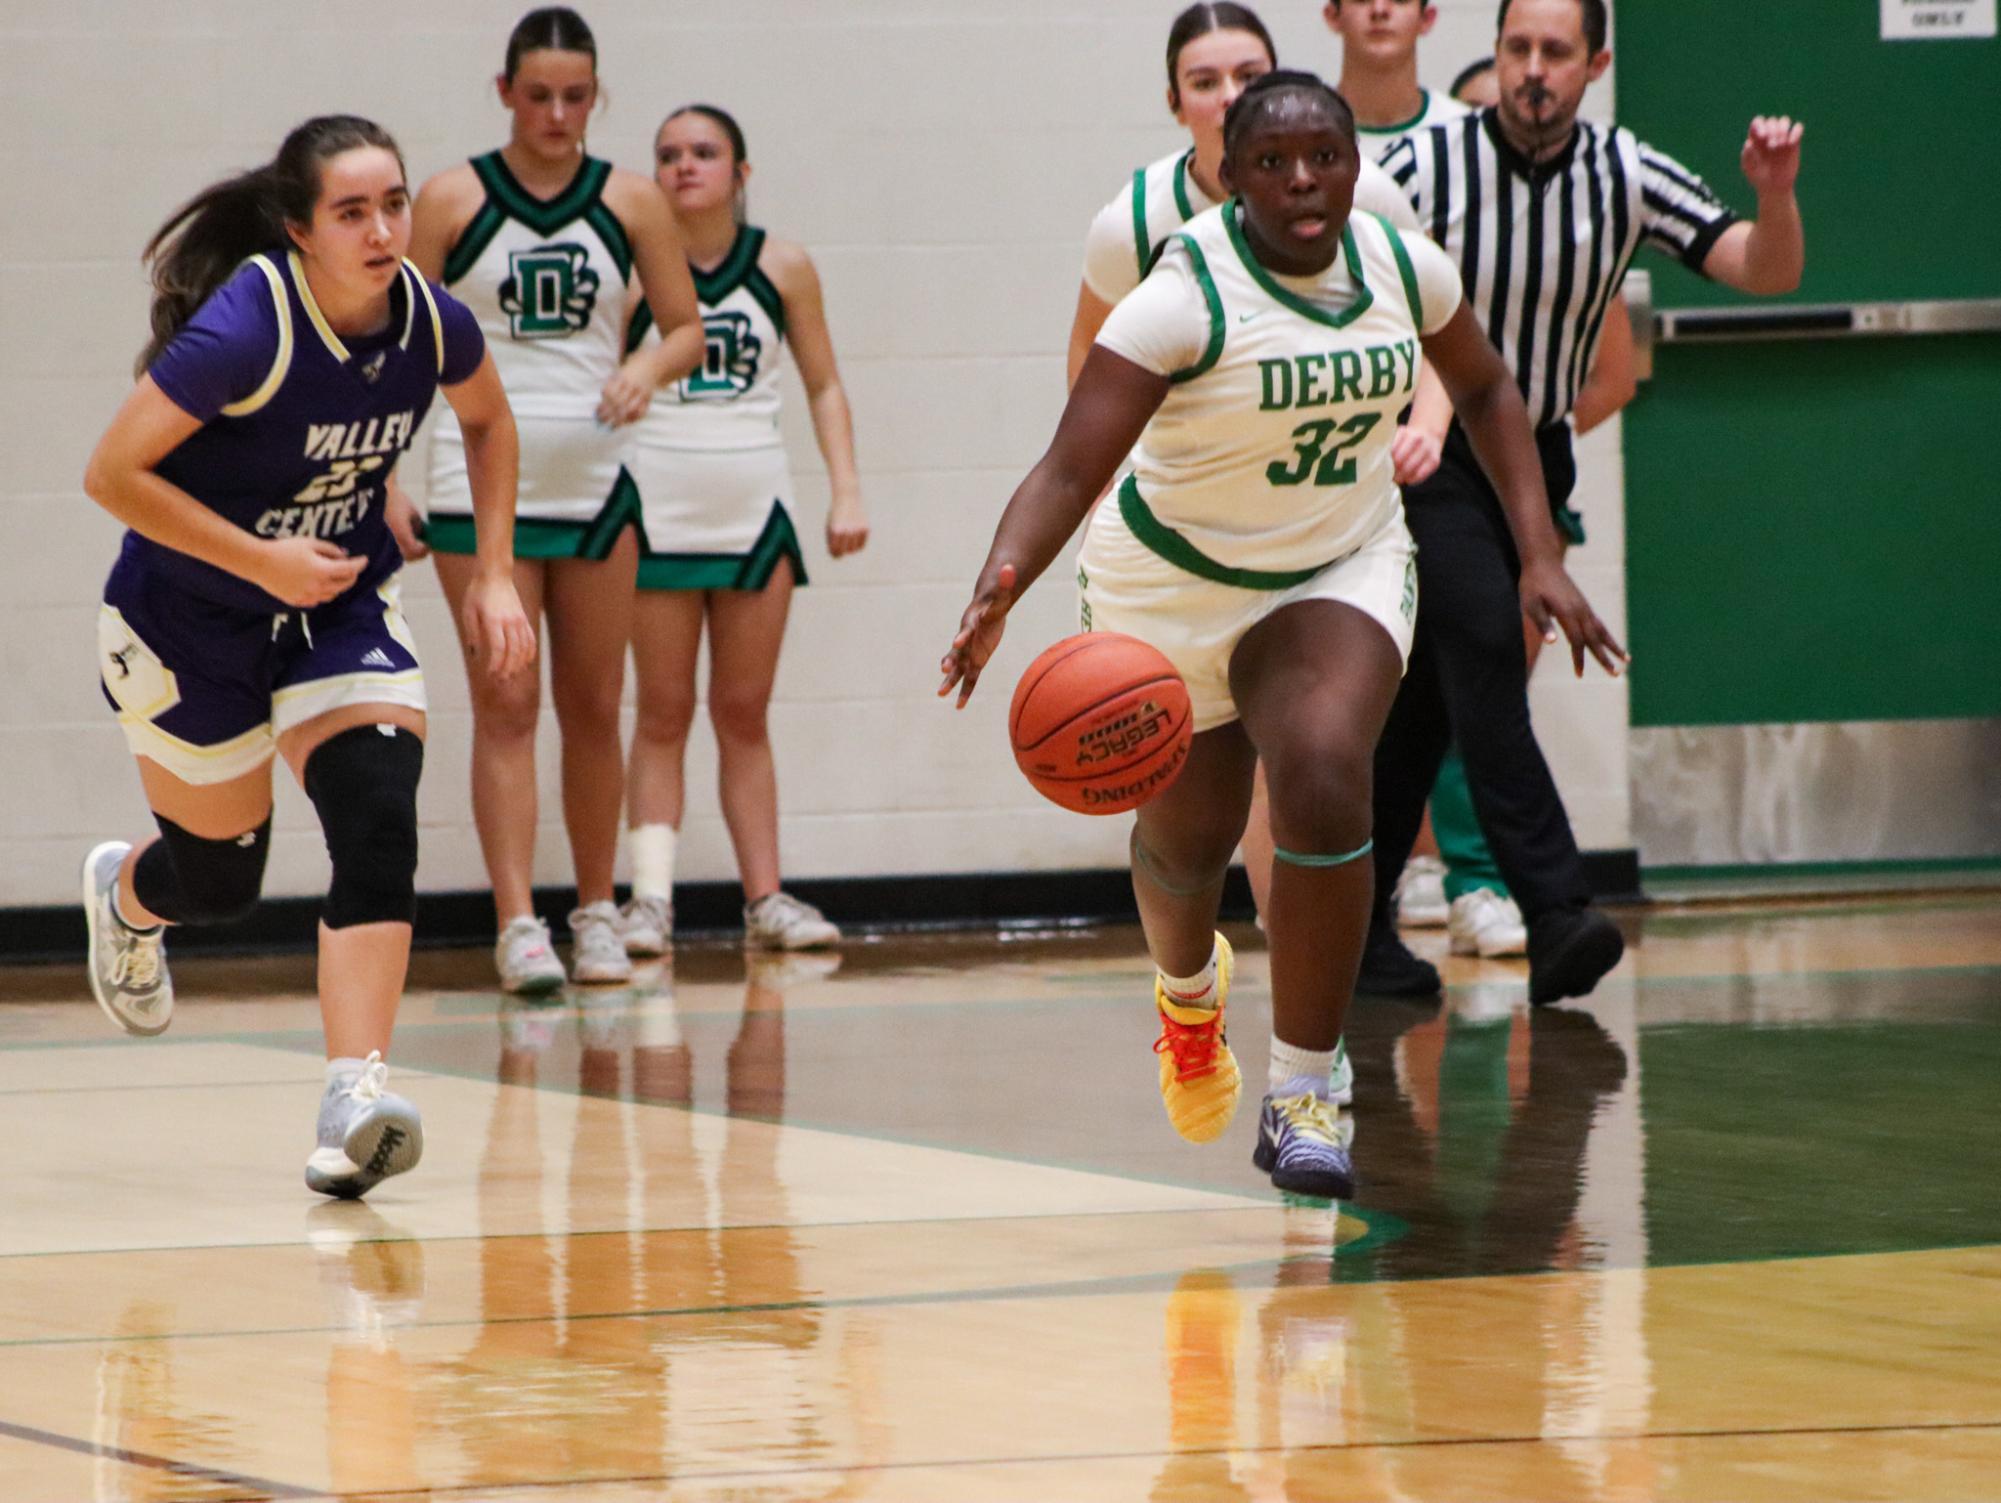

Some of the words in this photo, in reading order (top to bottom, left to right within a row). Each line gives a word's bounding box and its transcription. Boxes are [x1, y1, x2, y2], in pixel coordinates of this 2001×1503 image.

[1257, 337, 1415, 412] DERBY
[304, 410, 414, 461] VALLEY
[1265, 411, 1382, 487] 32
[1075, 707, 1172, 767] LEGACY
